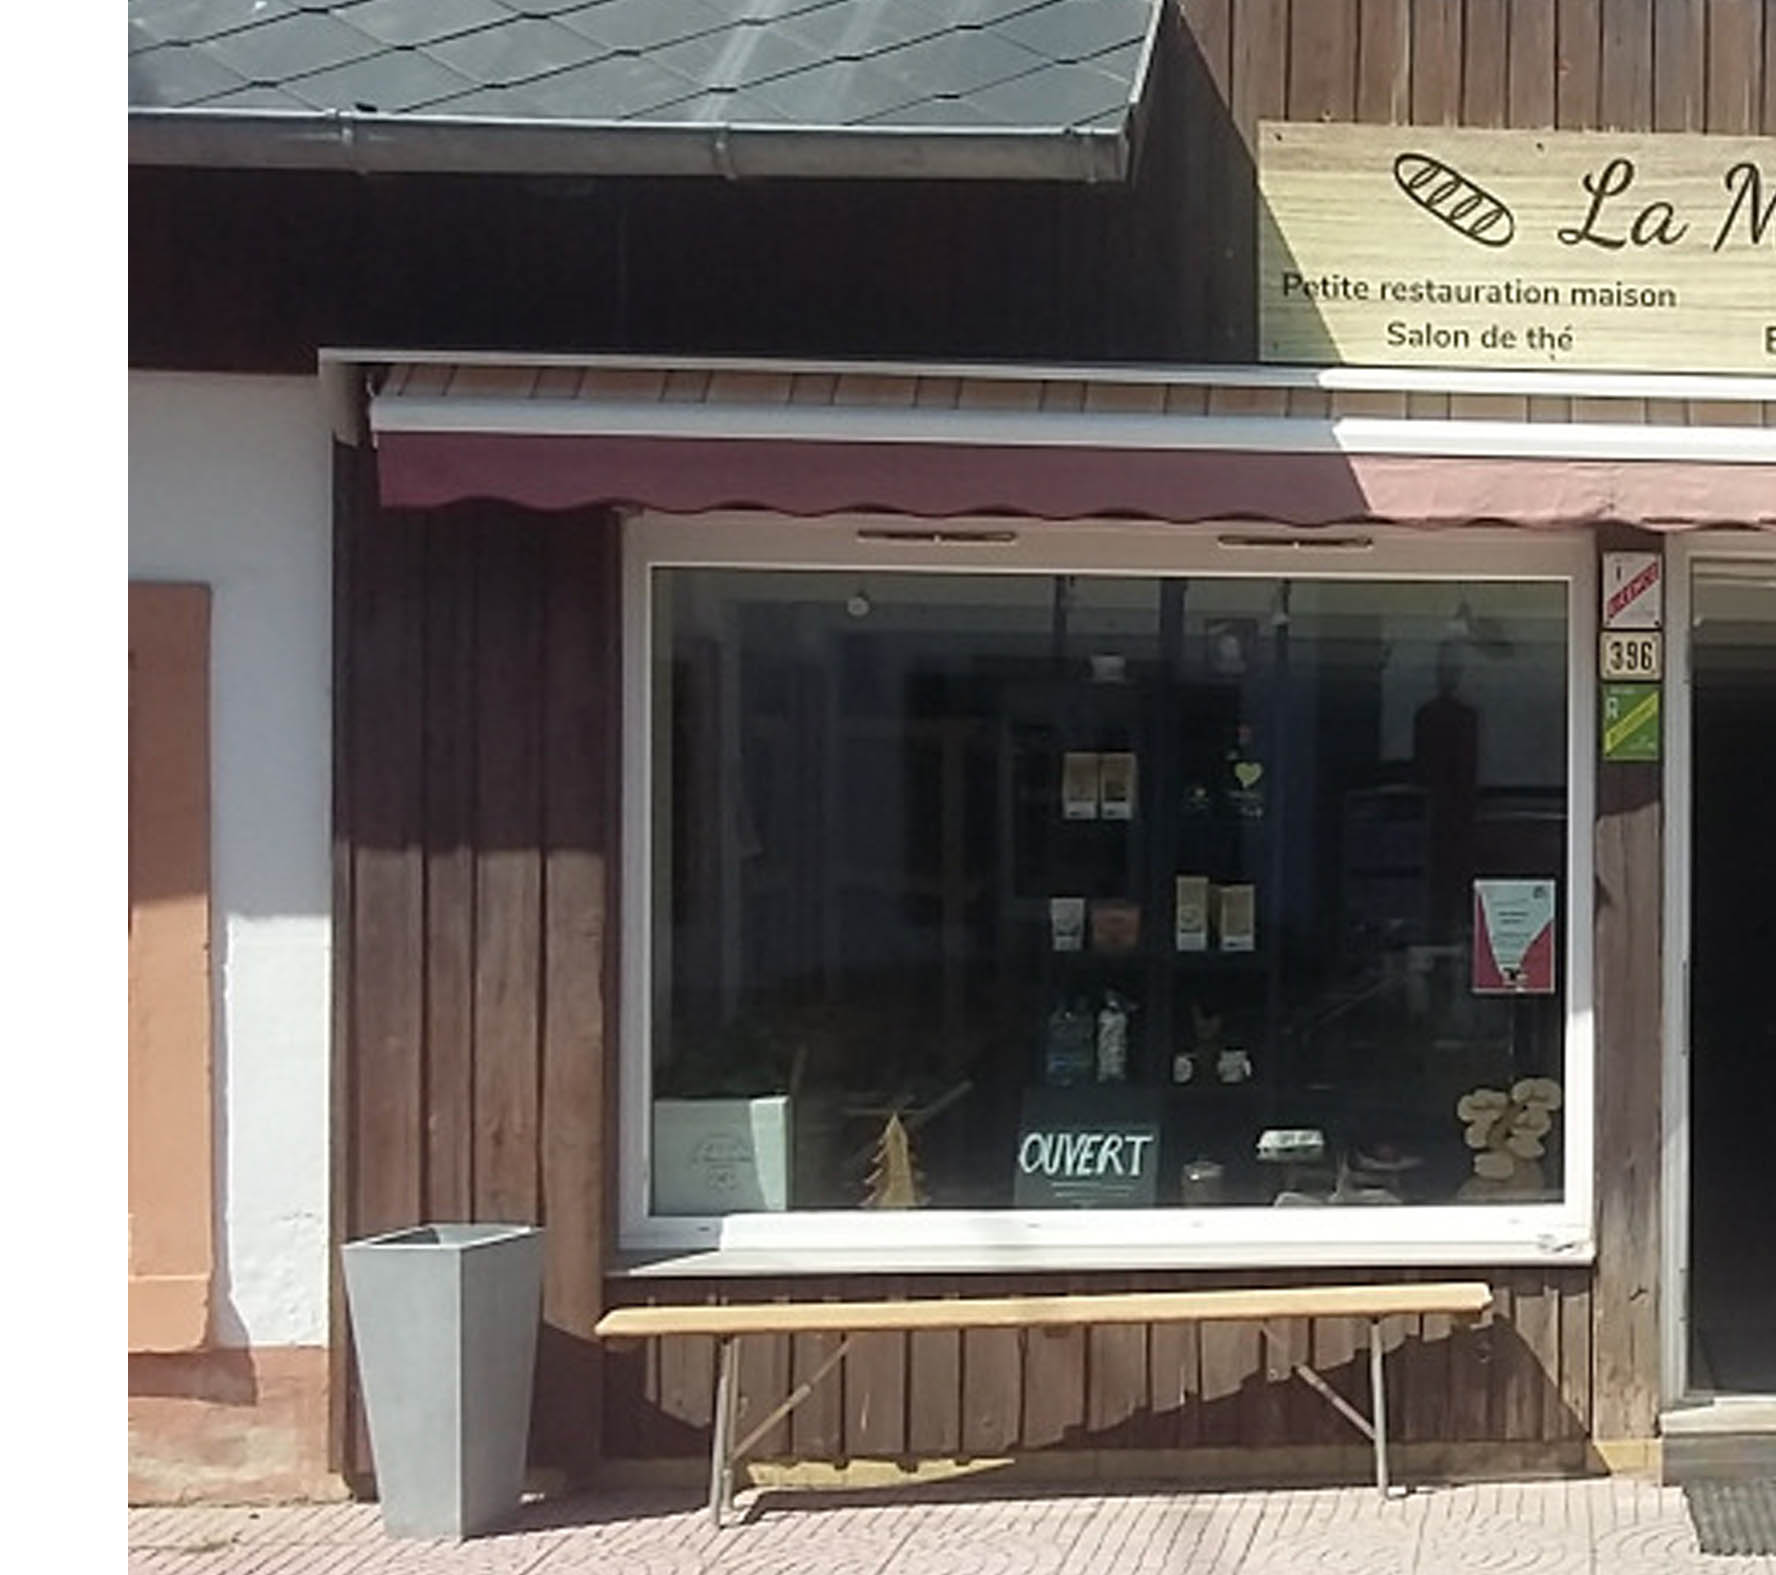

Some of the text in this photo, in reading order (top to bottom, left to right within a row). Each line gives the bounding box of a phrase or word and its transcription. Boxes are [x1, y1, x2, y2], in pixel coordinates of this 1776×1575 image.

[1558, 157, 1690, 250] La
[1282, 271, 1678, 308] Petite restauration maison
[1386, 320, 1575, 351] Salon de thé
[1609, 641, 1653, 671] 396
[1019, 1132, 1154, 1176] OUVERT
